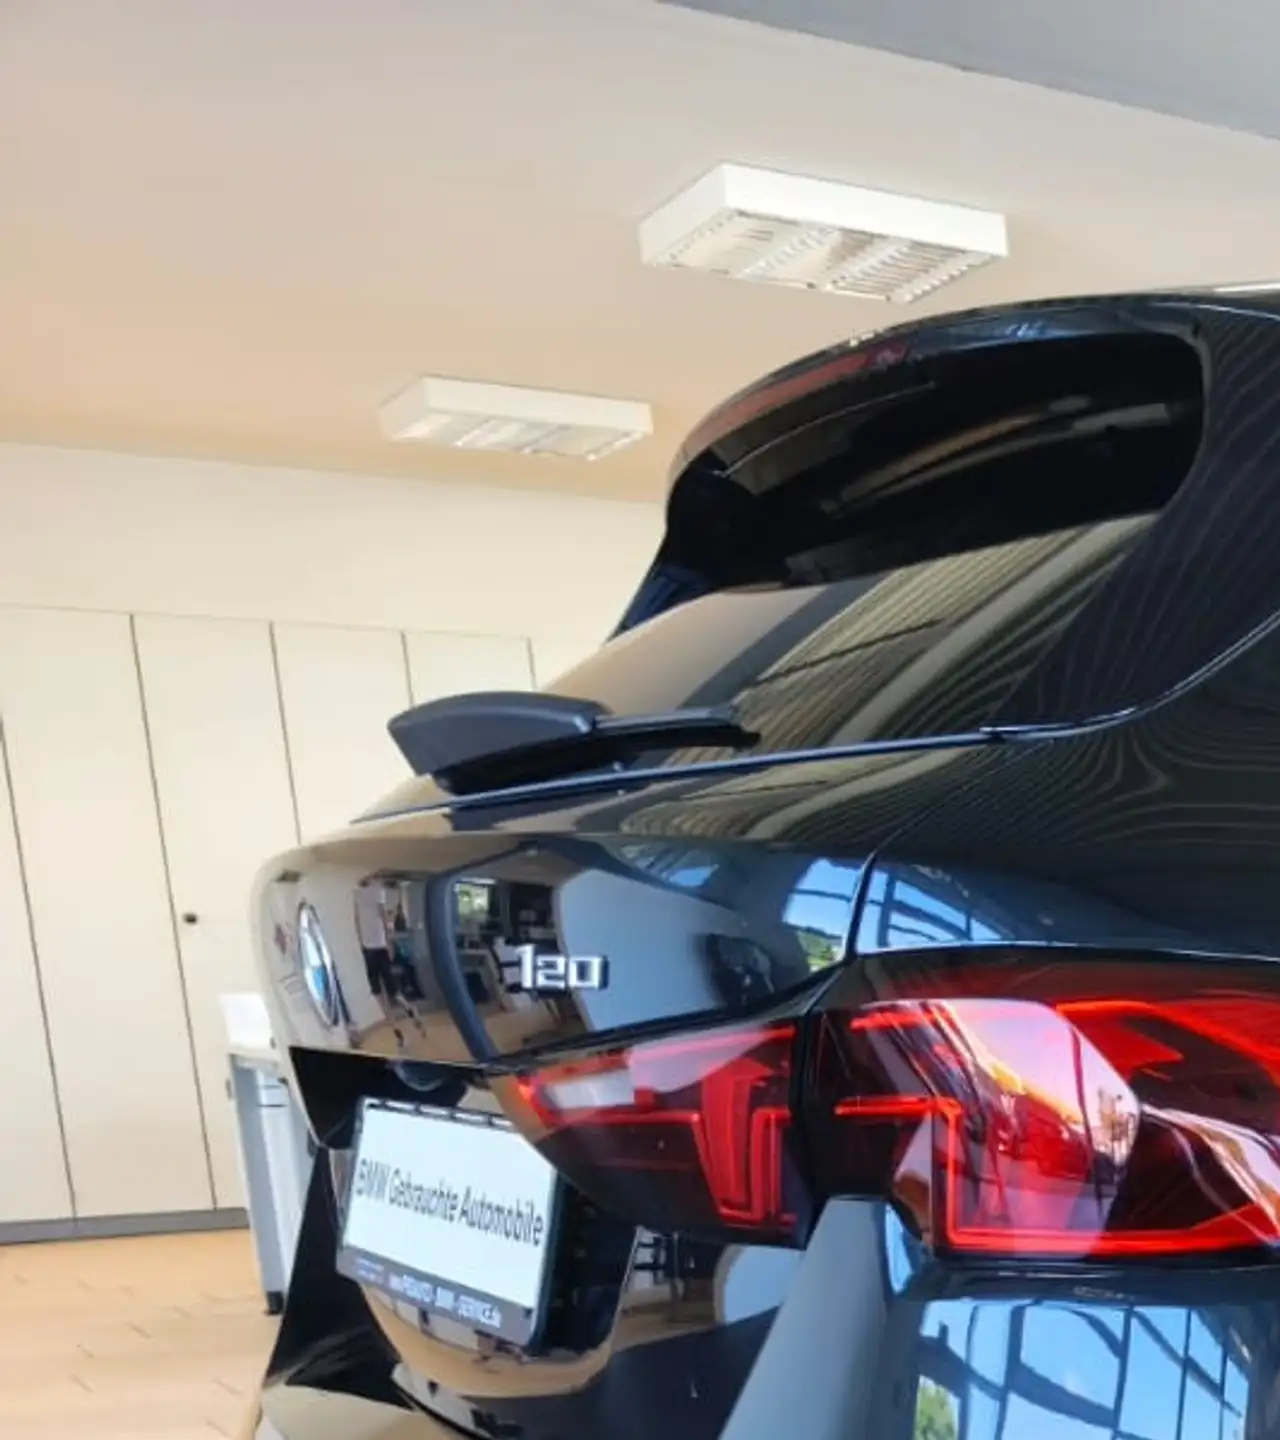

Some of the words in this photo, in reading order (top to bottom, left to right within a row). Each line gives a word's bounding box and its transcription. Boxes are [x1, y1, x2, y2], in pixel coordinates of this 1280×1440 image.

[515, 943, 604, 990] 120
[355, 1157, 391, 1203] BMW
[458, 1186, 544, 1247] Automobile
